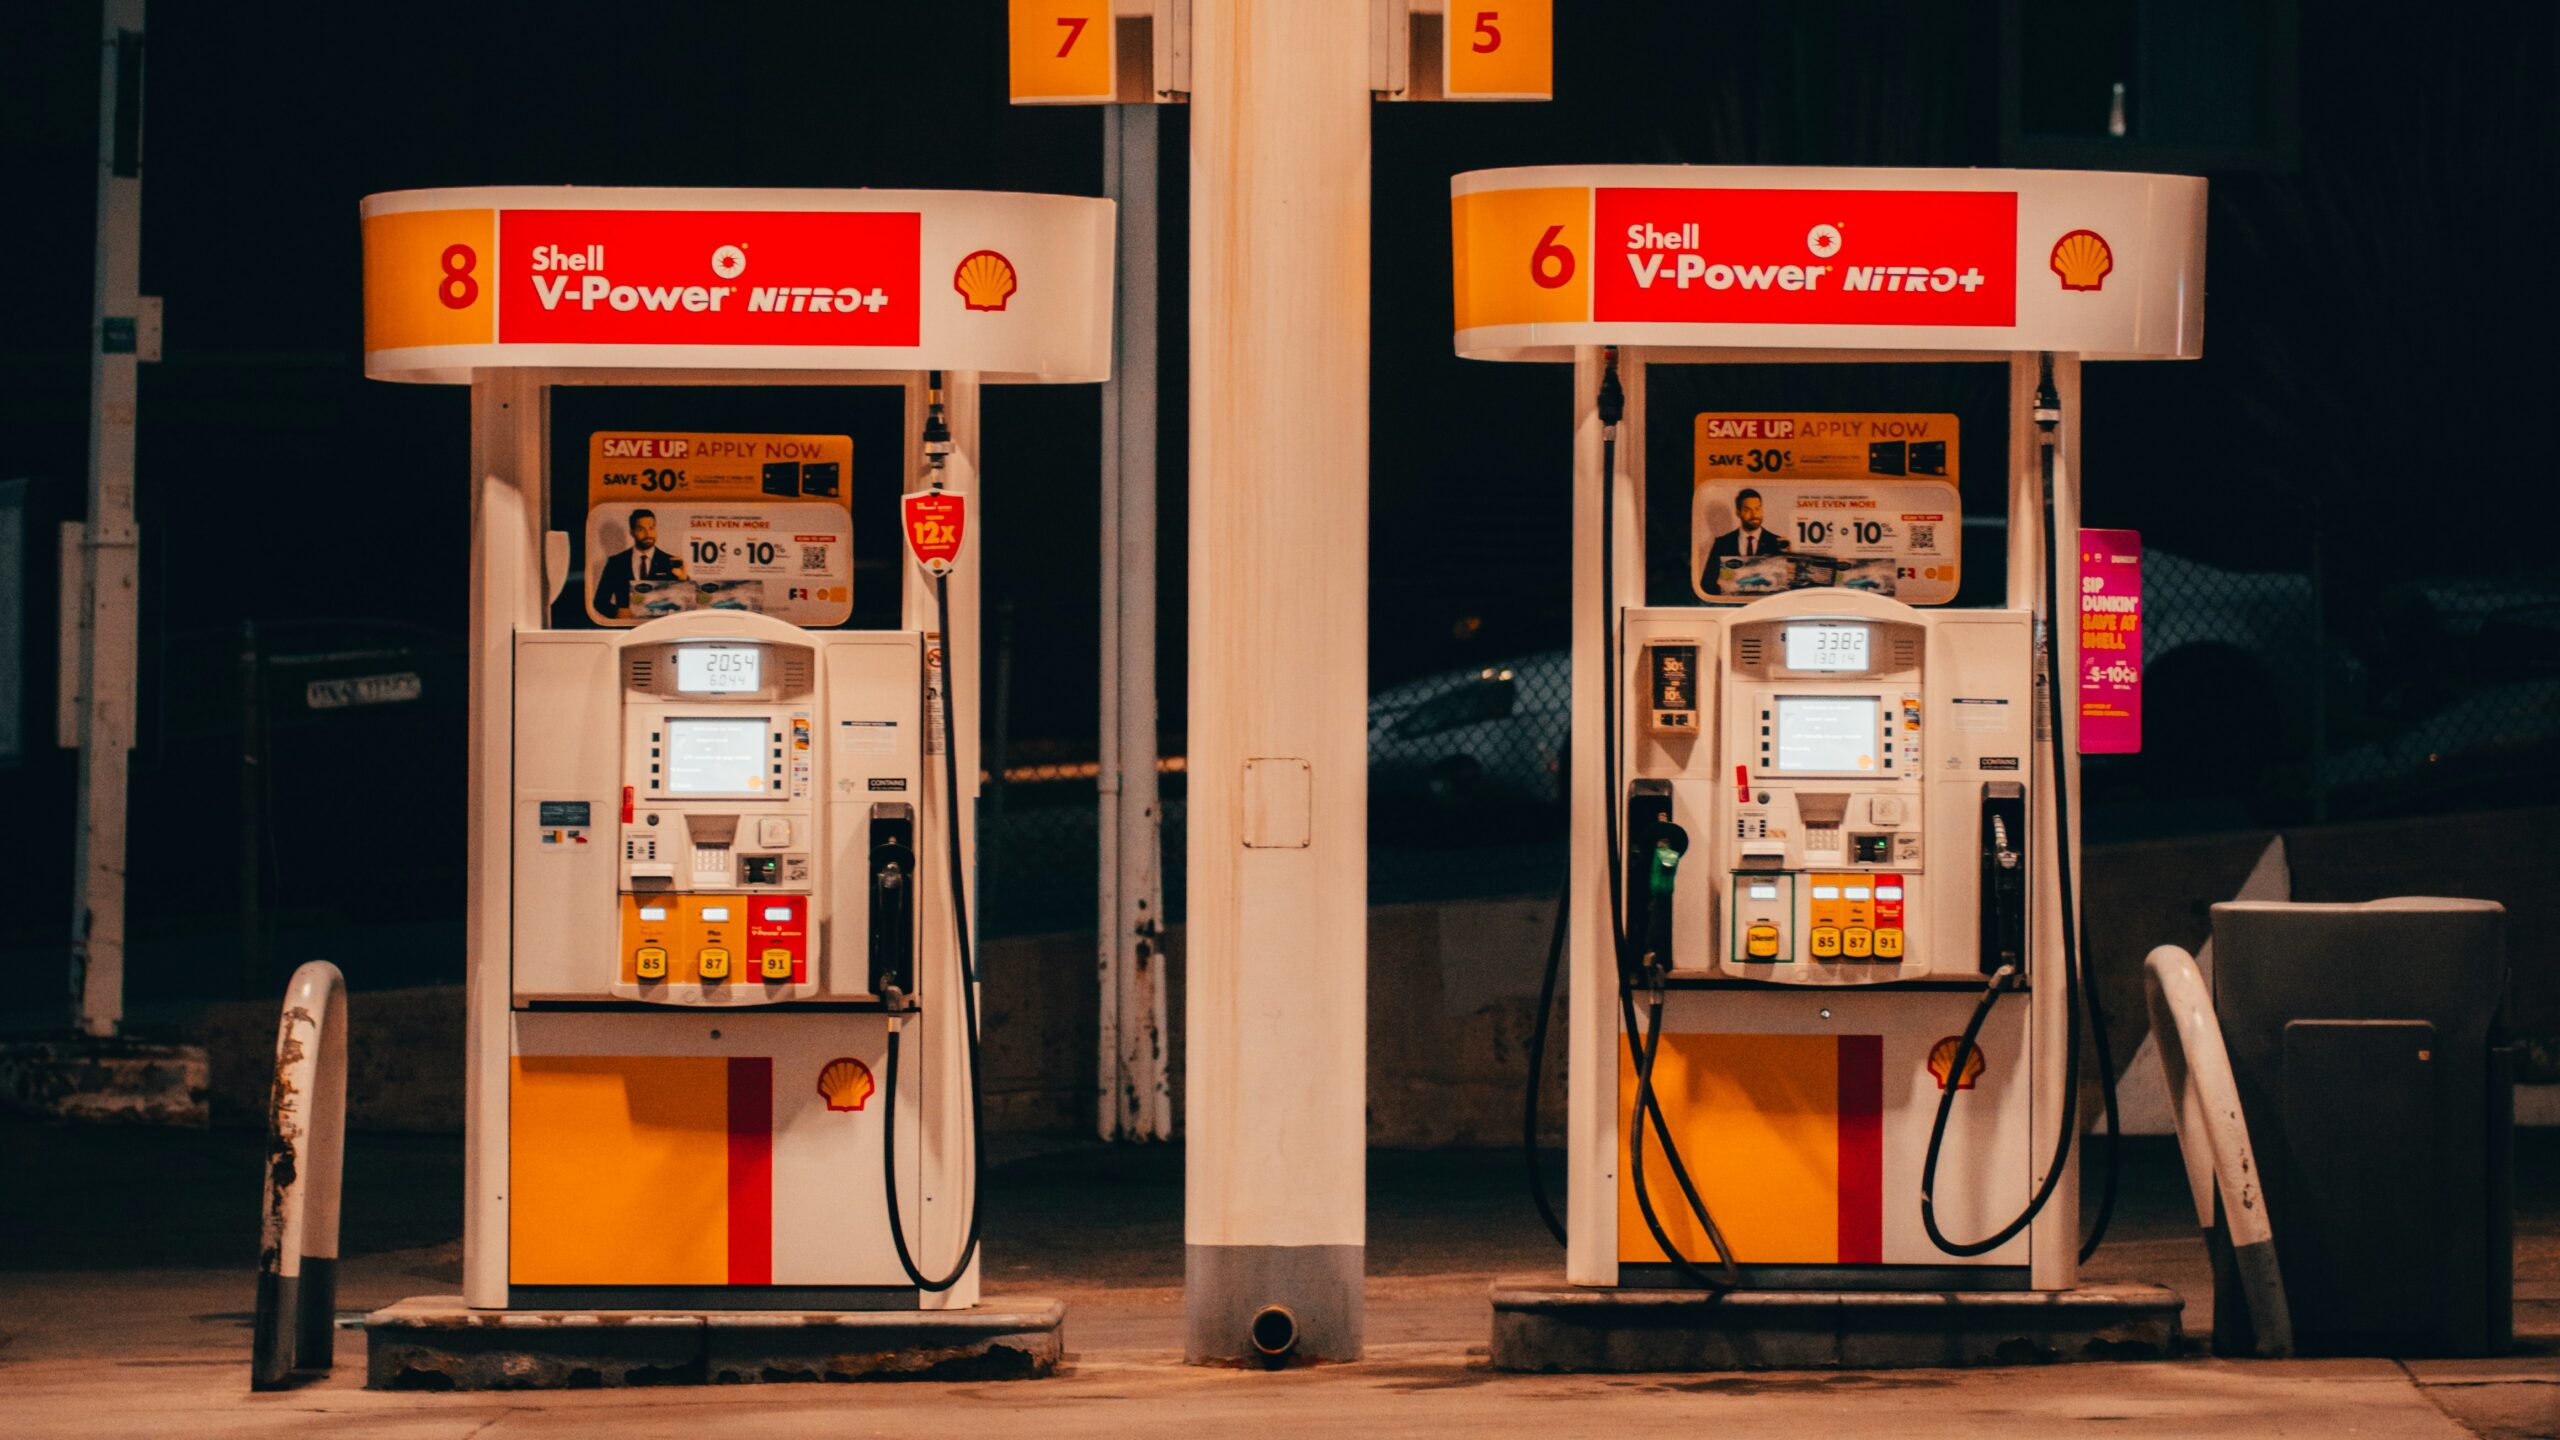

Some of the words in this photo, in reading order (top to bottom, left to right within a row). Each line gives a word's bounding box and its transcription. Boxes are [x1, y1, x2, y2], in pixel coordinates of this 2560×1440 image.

[1055, 17, 1089, 58] 7
[1472, 11, 1502, 54] 5
[1626, 223, 1700, 250] Shell
[531, 245, 605, 272] Shell
[1530, 224, 1575, 290] 6
[438, 243, 479, 309] 8
[1626, 253, 1827, 291] V-Power
[531, 274, 727, 312] V-Power
[1708, 420, 1757, 438] SAVE
[1764, 421, 1793, 438] UP.
[1801, 422, 1863, 438] APPLY
[603, 439, 652, 458] SAVE
[659, 440, 688, 458] UP.
[696, 441, 758, 458] APPLY
[1708, 454, 1743, 466] SAVE
[603, 473, 638, 486] SAVE
[1797, 500, 1820, 509] SAVE
[1823, 500, 1846, 509] EVEN
[1850, 500, 1876, 509] MORE
[690, 520, 713, 529] SAVE
[716, 520, 739, 529] EVEN
[743, 520, 769, 529] MORE
[914, 521, 956, 544] 12x
[2082, 576, 2104, 593] SIP
[2082, 613, 2117, 631] SAVE
[2120, 614, 2138, 631] AT
[2082, 632, 2127, 649] SHELL
[1818, 937, 1835, 947] 85
[1849, 937, 1866, 948] 87
[1880, 937, 1896, 948] 91
[642, 958, 660, 969] 85
[705, 958, 722, 969] 87
[767, 958, 785, 970] 91
